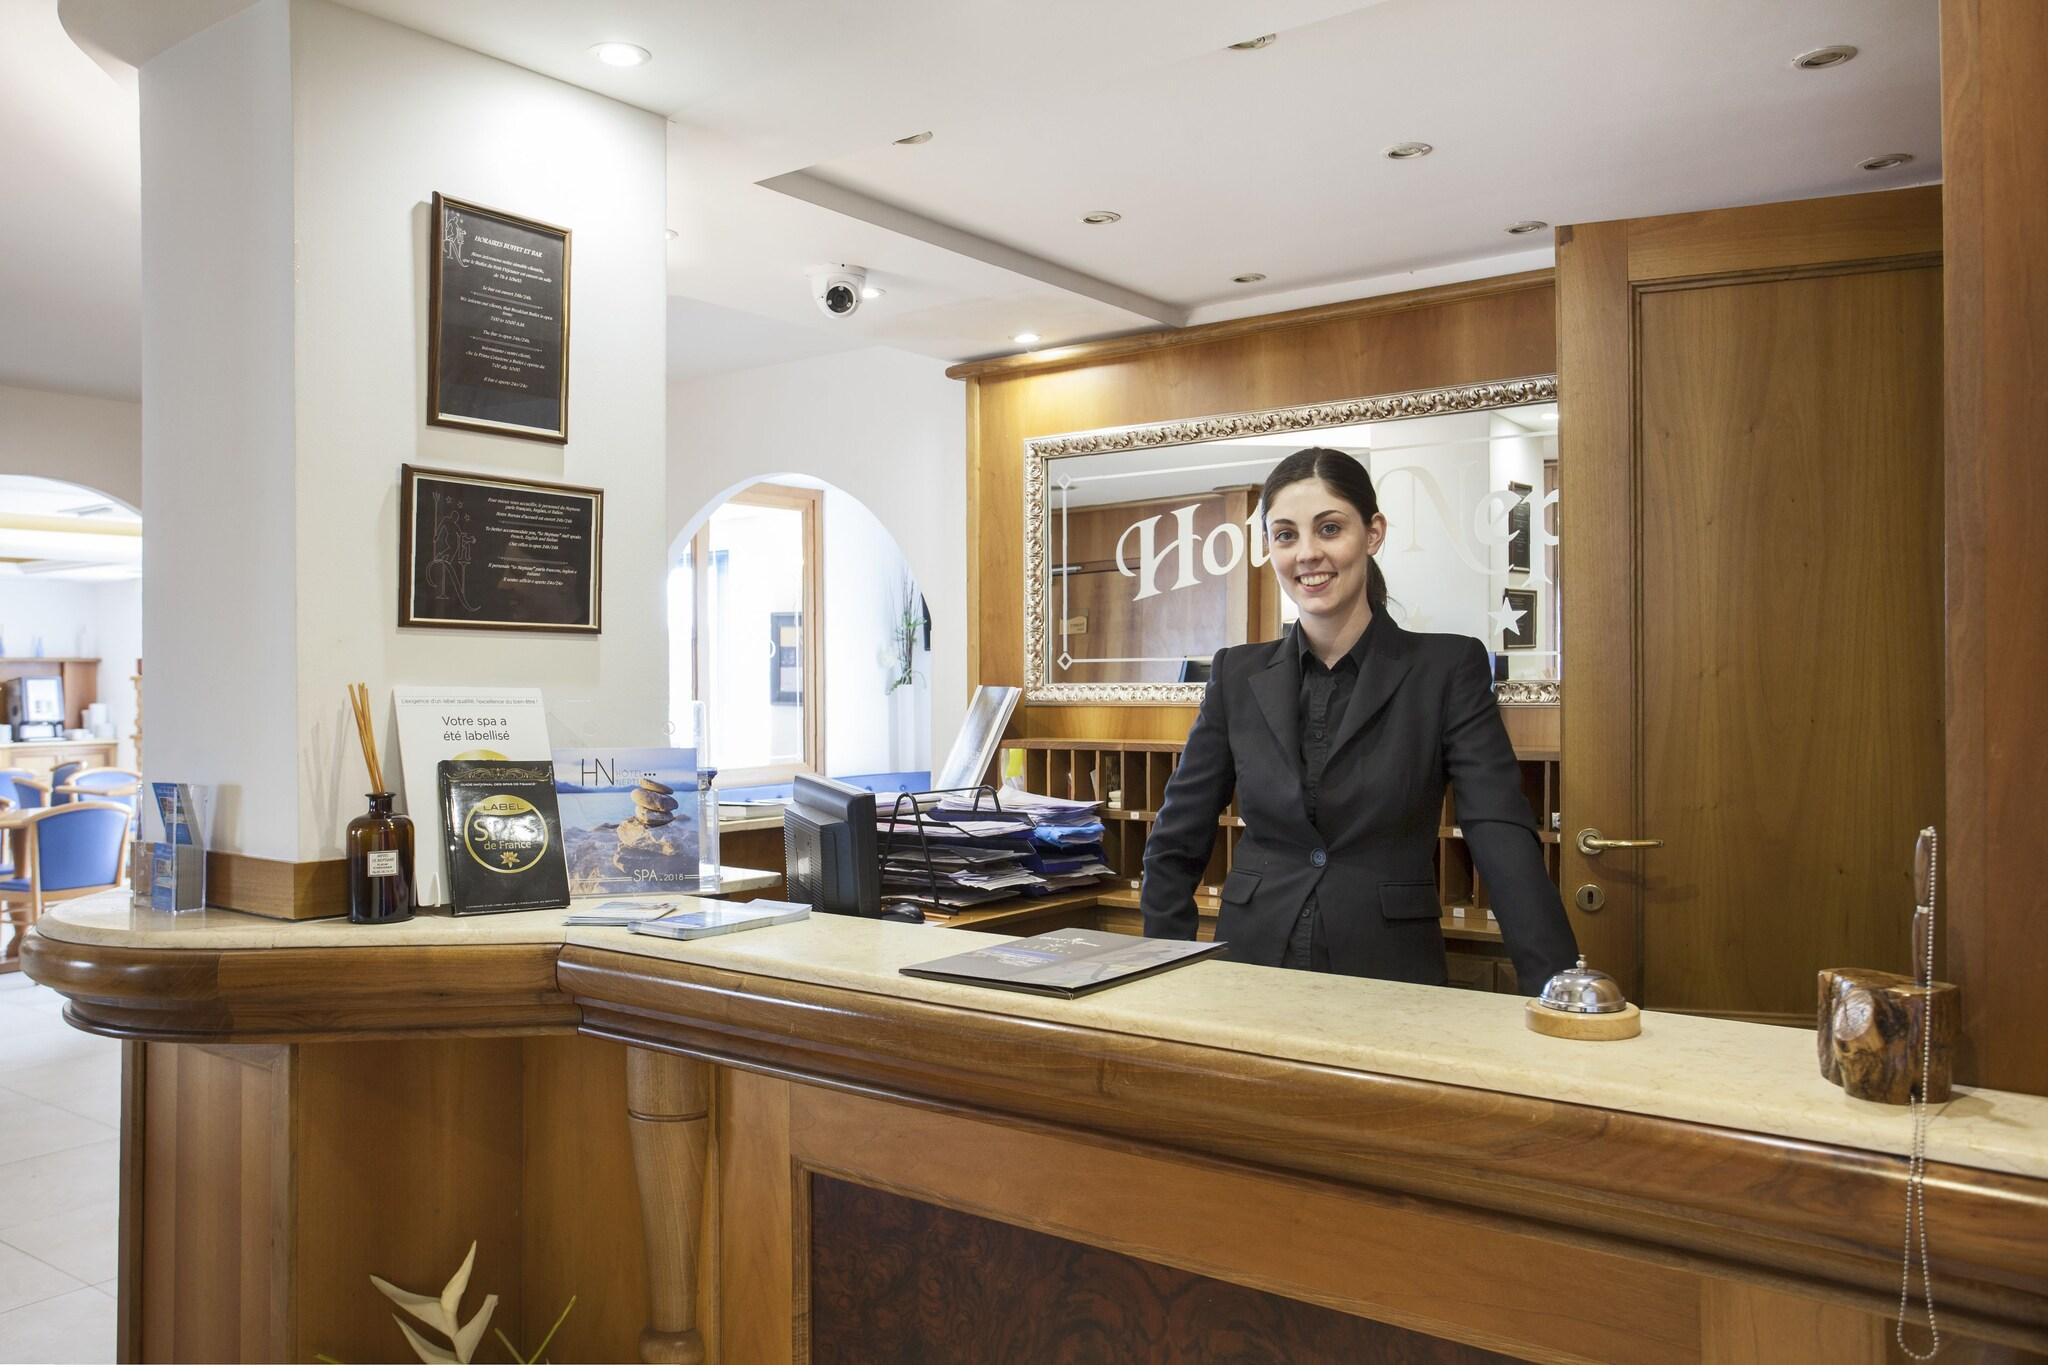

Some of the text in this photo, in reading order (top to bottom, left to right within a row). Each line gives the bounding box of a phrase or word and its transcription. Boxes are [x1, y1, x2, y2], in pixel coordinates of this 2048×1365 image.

[475, 236, 503, 247] HORAIRES
[503, 243, 523, 252] BUFFET
[1115, 497, 1273, 602] Hot
[1376, 459, 1559, 587] Nep
[442, 716, 507, 727] Votre spa a
[444, 730, 510, 740] été labellisé
[484, 841, 532, 850] de France
